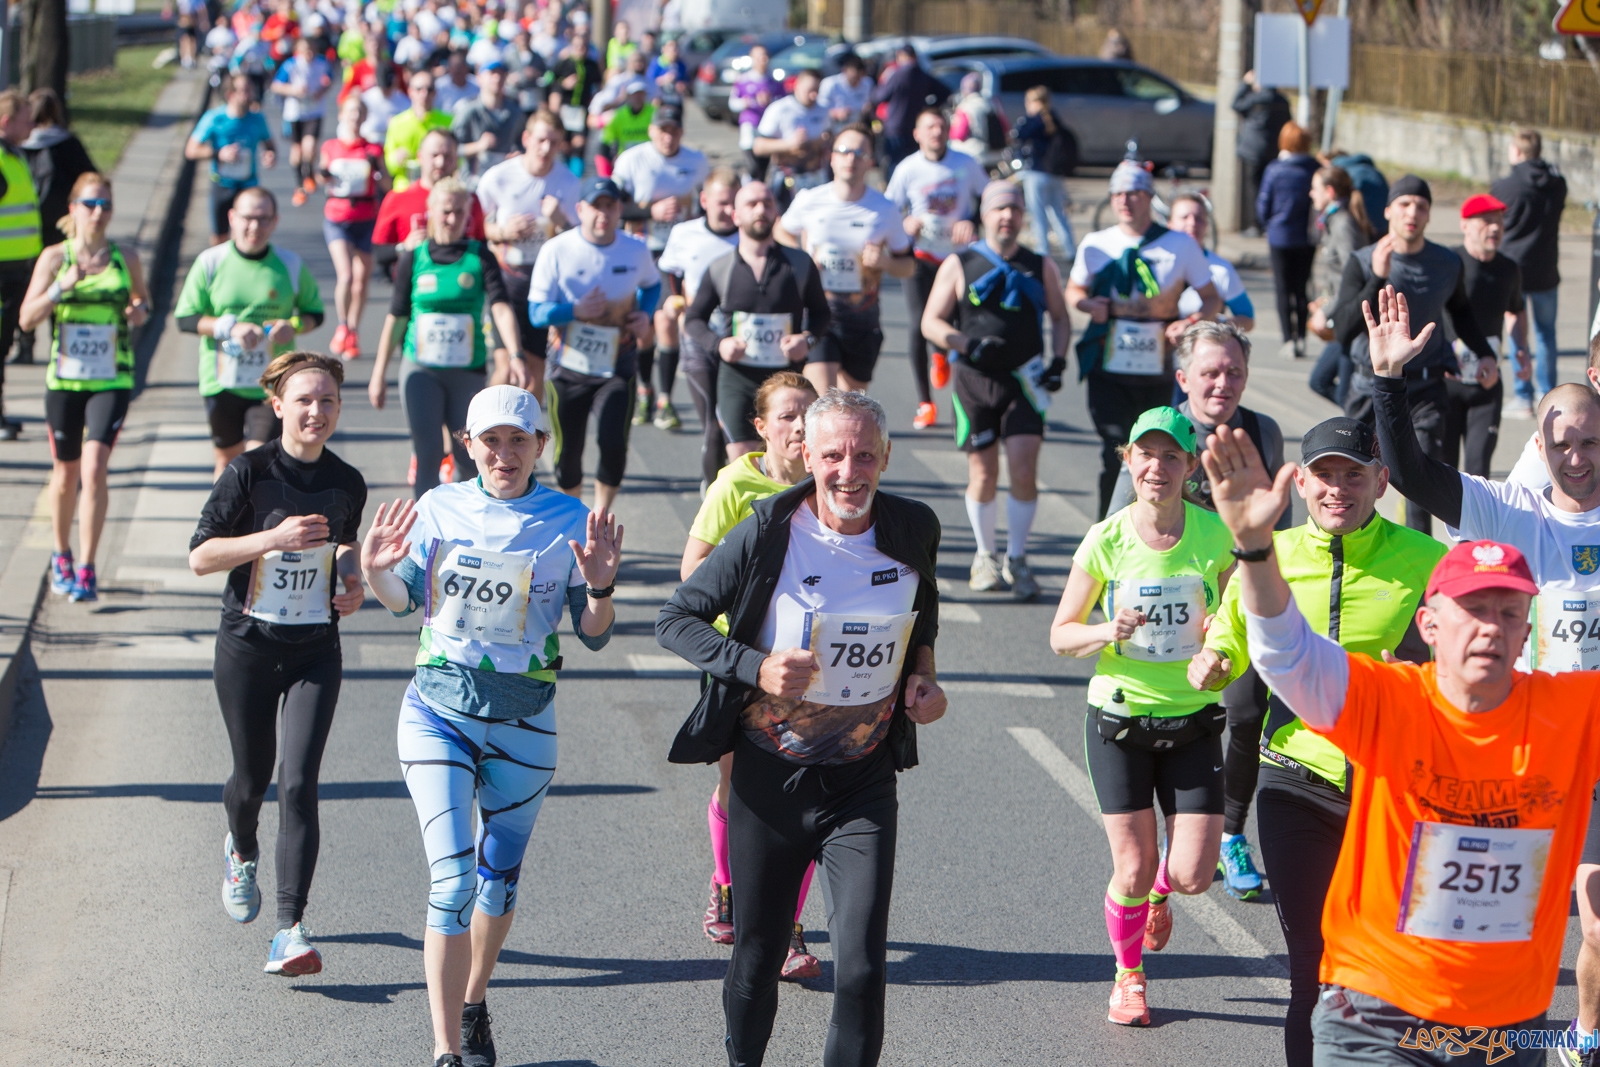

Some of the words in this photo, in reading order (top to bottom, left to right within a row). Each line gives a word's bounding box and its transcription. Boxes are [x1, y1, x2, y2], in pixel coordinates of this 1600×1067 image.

[69, 340, 109, 356] 6229
[272, 567, 318, 591] 3117
[803, 575, 822, 587] 4F
[882, 571, 897, 580] PKO
[444, 573, 513, 606] 6769
[464, 603, 487, 613] Marta
[830, 641, 896, 668] 7861
[1576, 645, 1599, 654] Marek
[851, 671, 873, 680] Jerzy
[1438, 860, 1522, 894] 2513
